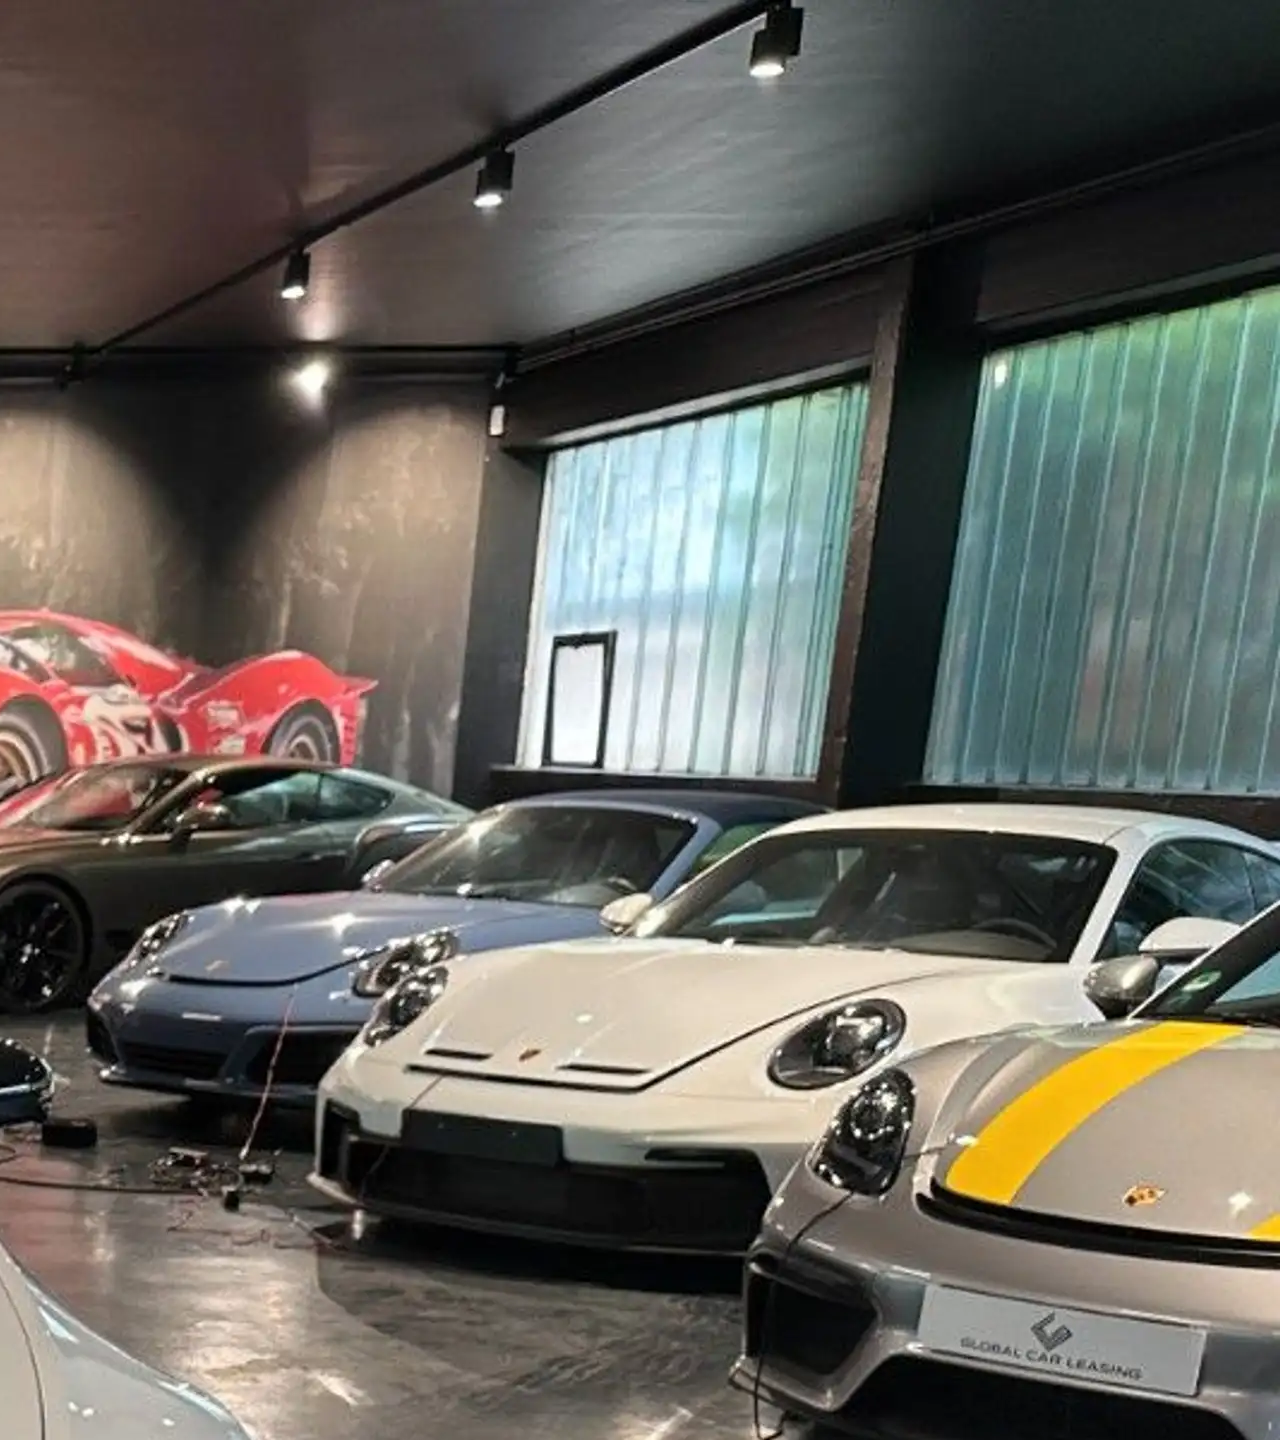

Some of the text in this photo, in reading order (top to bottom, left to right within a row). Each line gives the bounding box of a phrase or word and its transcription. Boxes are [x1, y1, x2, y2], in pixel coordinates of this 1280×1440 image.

[959, 1336, 1143, 1381] GLOBAL CAR LEASING
